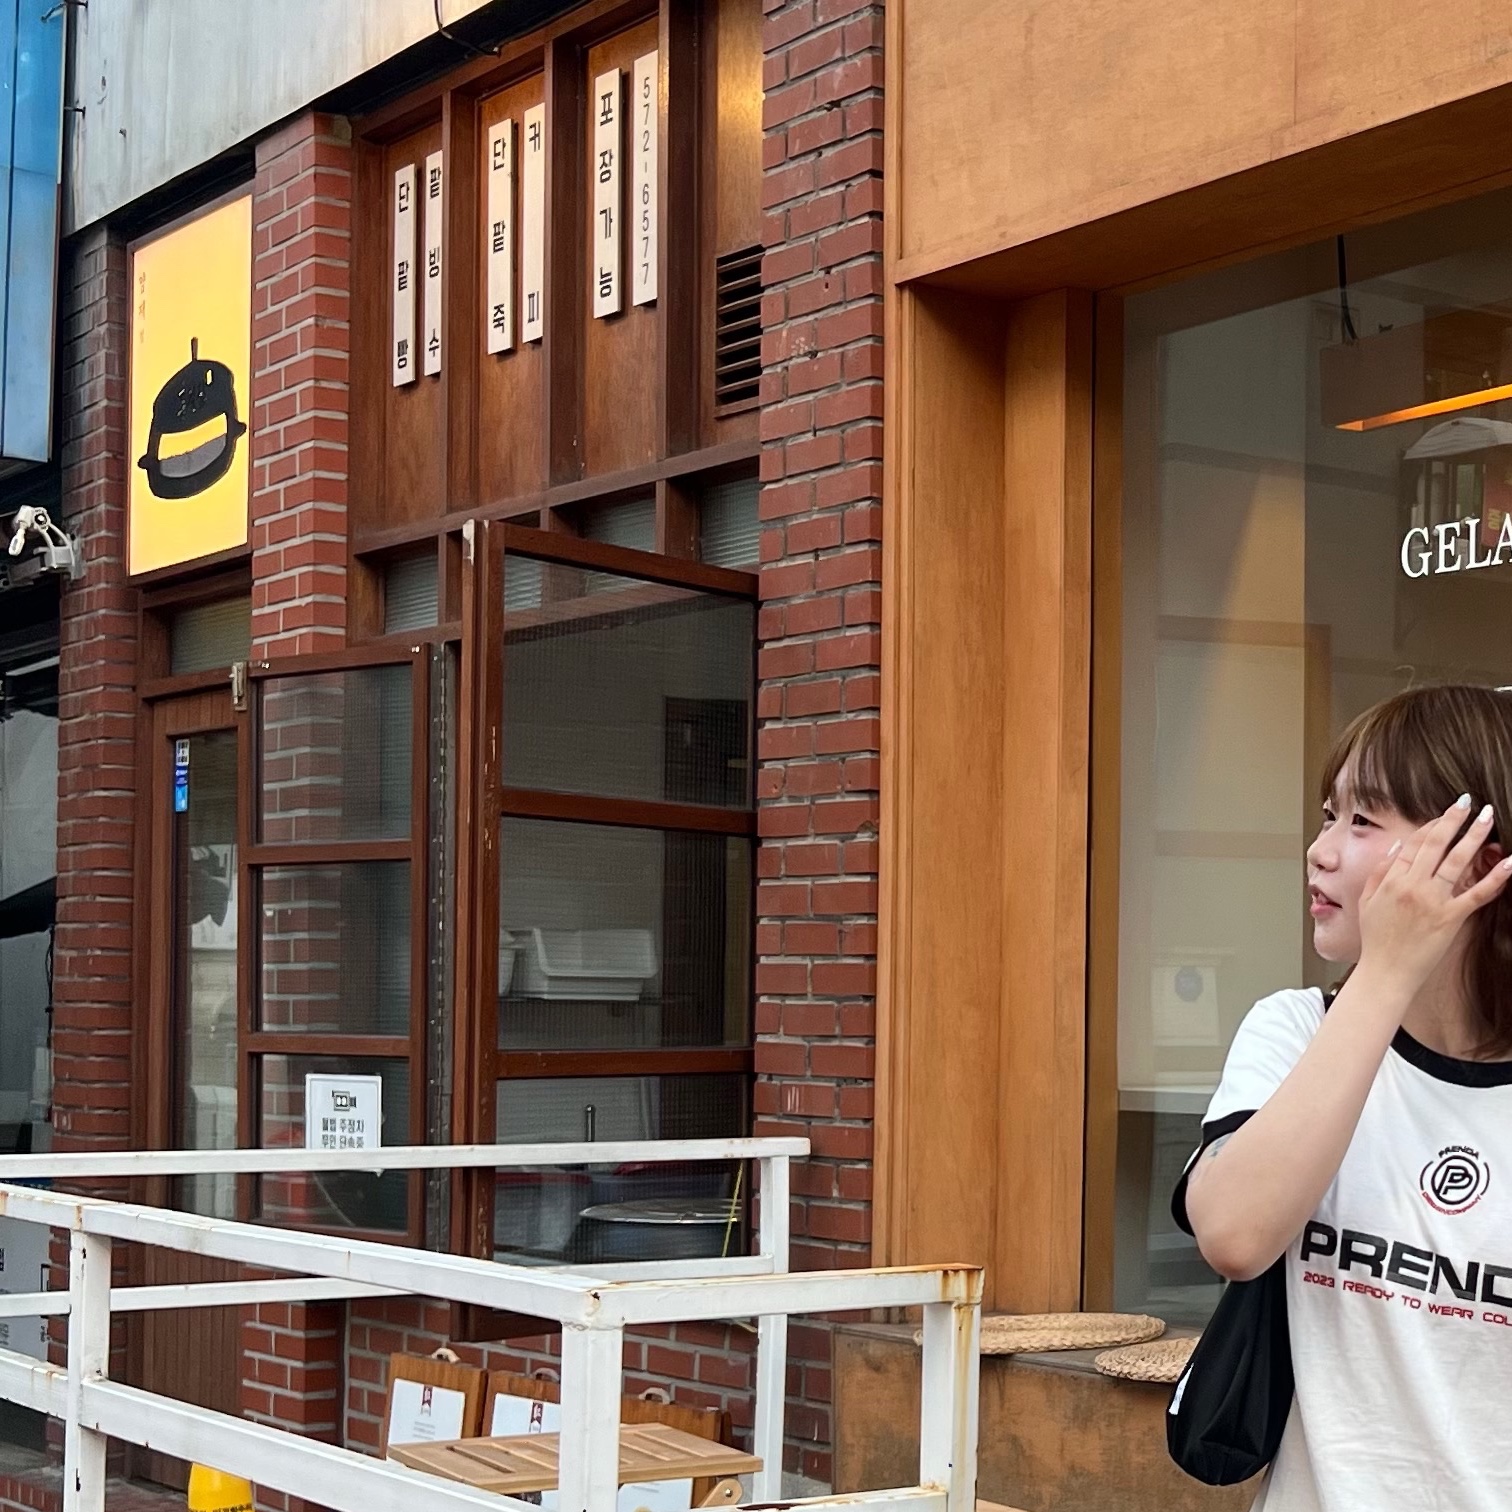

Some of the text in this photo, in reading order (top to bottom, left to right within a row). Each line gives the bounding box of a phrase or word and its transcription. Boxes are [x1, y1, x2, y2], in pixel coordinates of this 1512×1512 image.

[428, 166, 441, 358] 팥빙수
[492, 137, 506, 334] 단팥죽
[599, 91, 614, 299] 포장가능
[641, 76, 651, 286] 572-6577
[1438, 1146, 1479, 1160] PRENDA
[1303, 1271, 1335, 1289] 2023
[1343, 1280, 1394, 1302] READY
[1402, 1295, 1421, 1310] TO
[1428, 1303, 1474, 1320] WEAR
